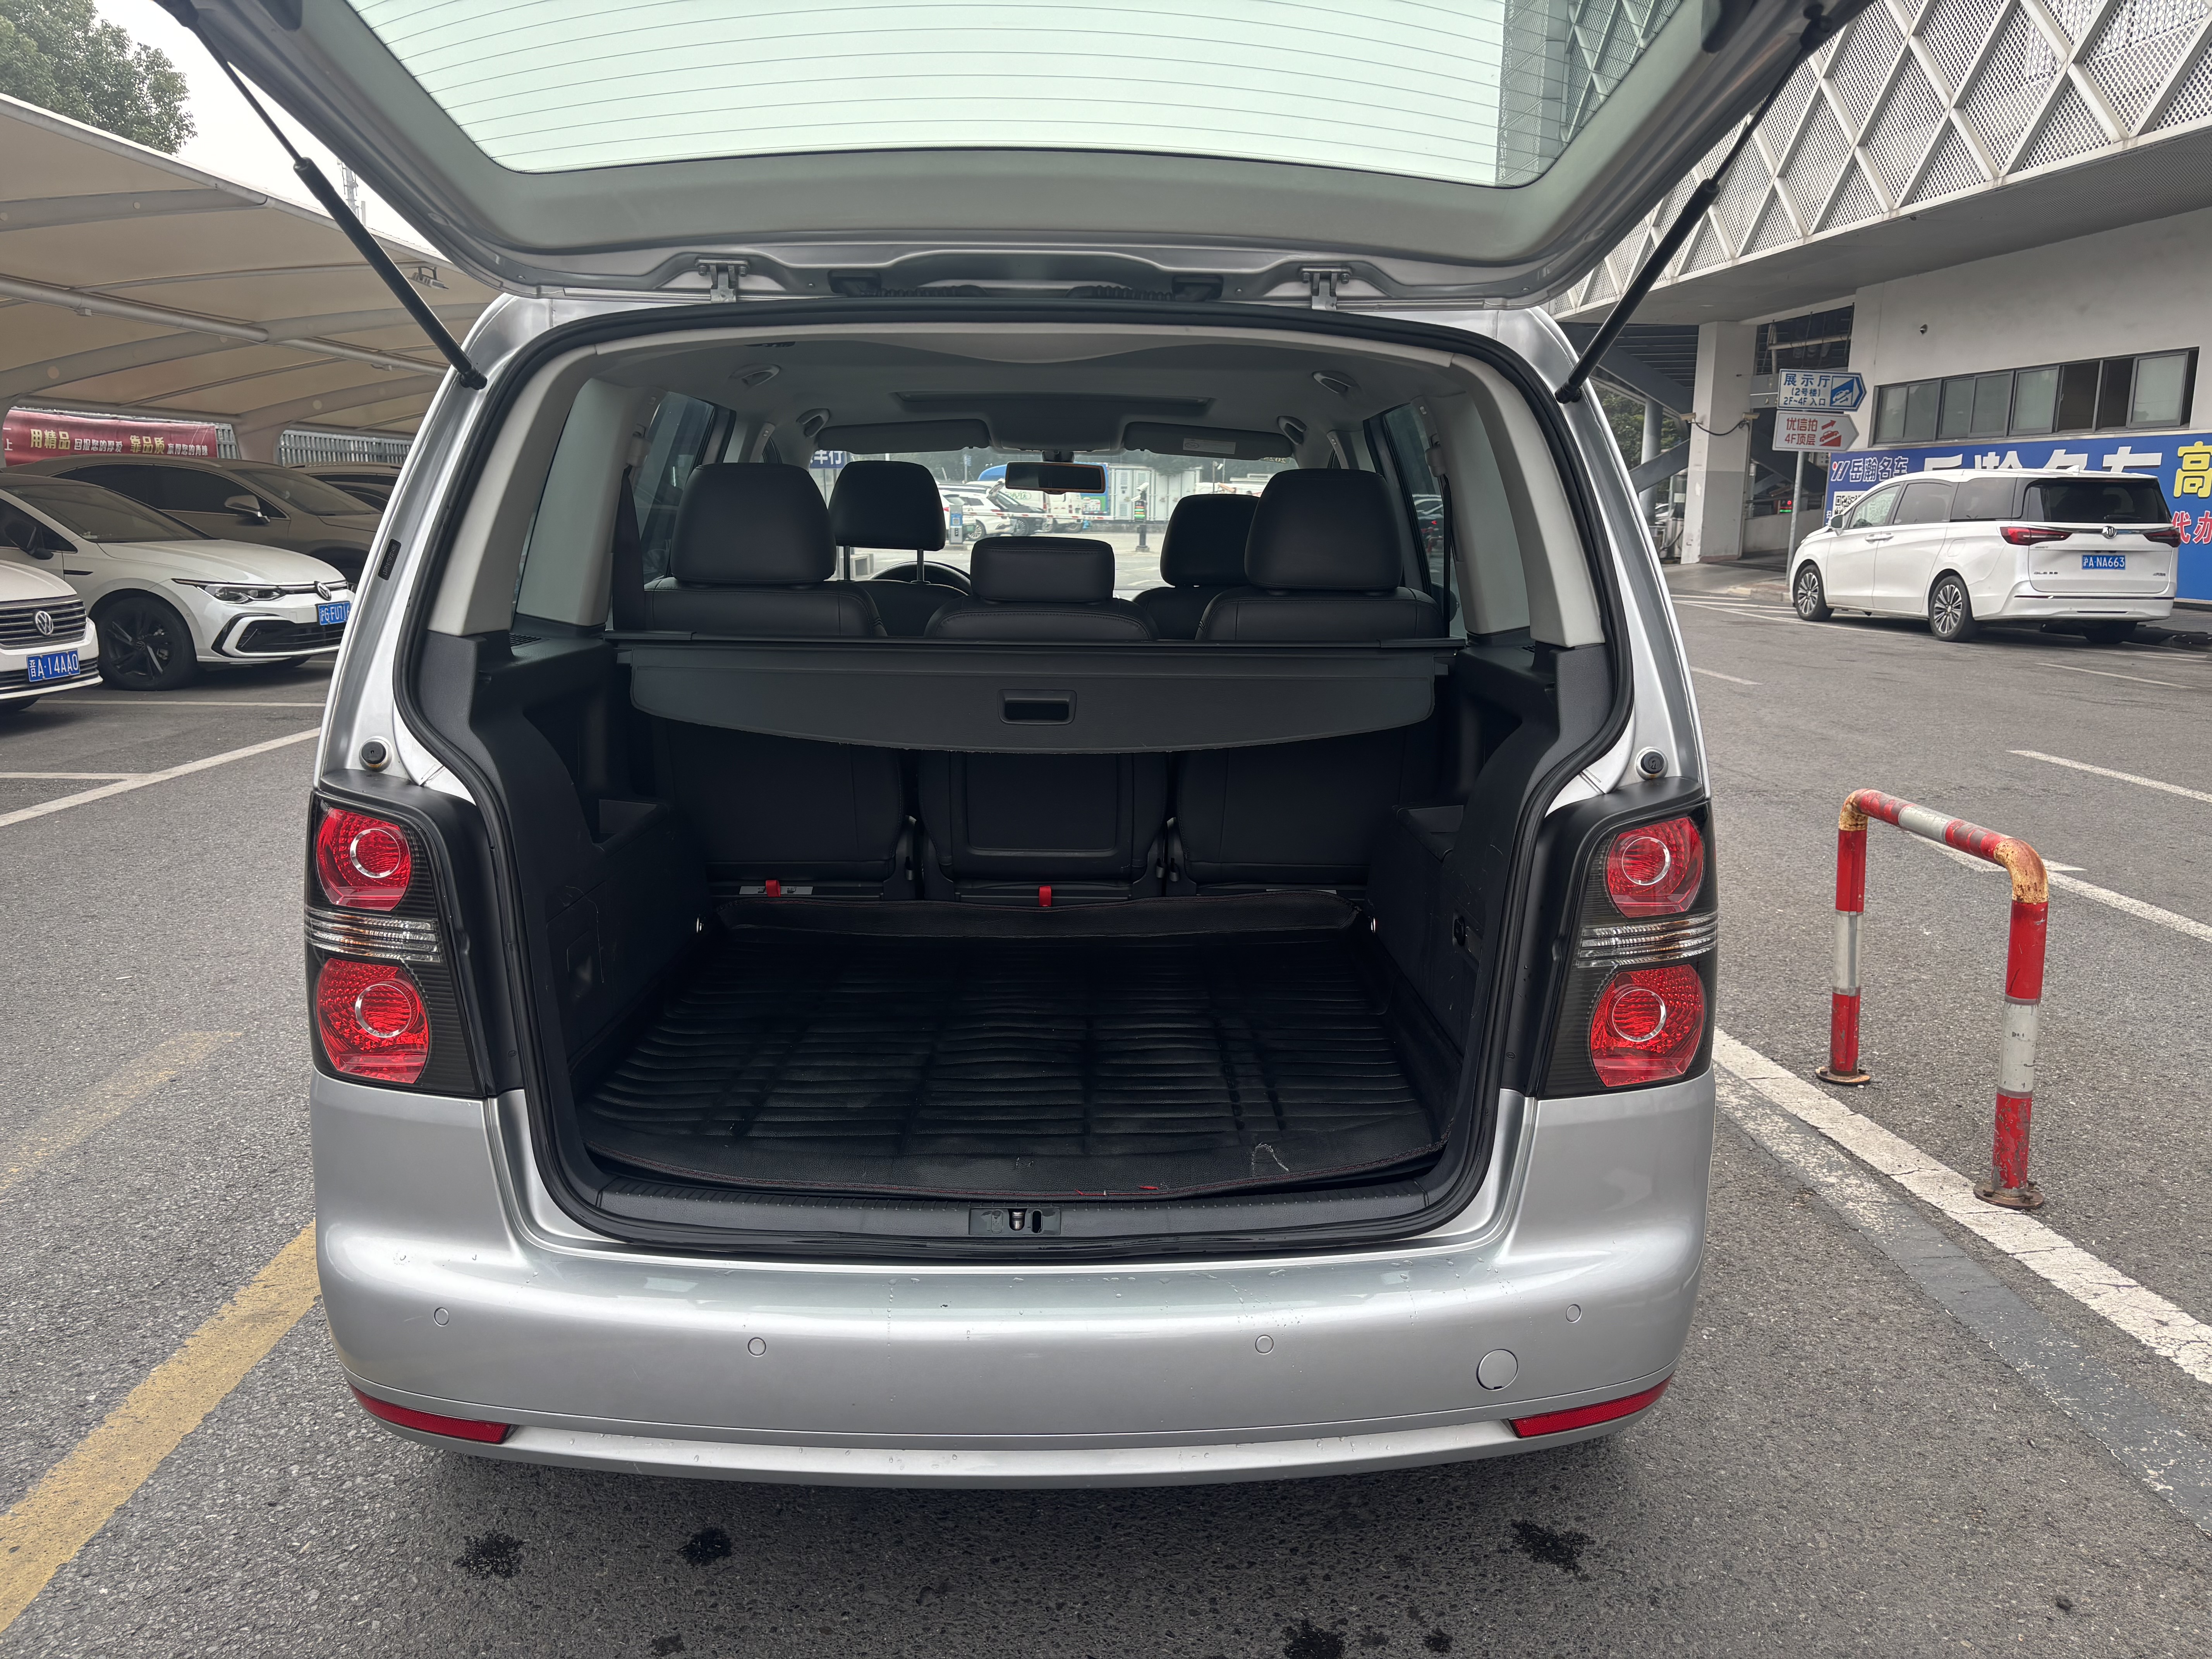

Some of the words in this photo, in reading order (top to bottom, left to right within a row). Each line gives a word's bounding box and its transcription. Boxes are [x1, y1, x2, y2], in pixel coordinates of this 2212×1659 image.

[1784, 373, 1831, 387] 展示厅
[1791, 387, 1821, 397] (2号楼)
[1810, 397, 1826, 406] 入口
[1786, 417, 1818, 432] 优信拍
[30, 429, 70, 450] 用精品
[130, 435, 165, 455] 靠品质
[1784, 433, 1816, 445] 4F顶层
[1849, 456, 1908, 483] 岳瀚名车
